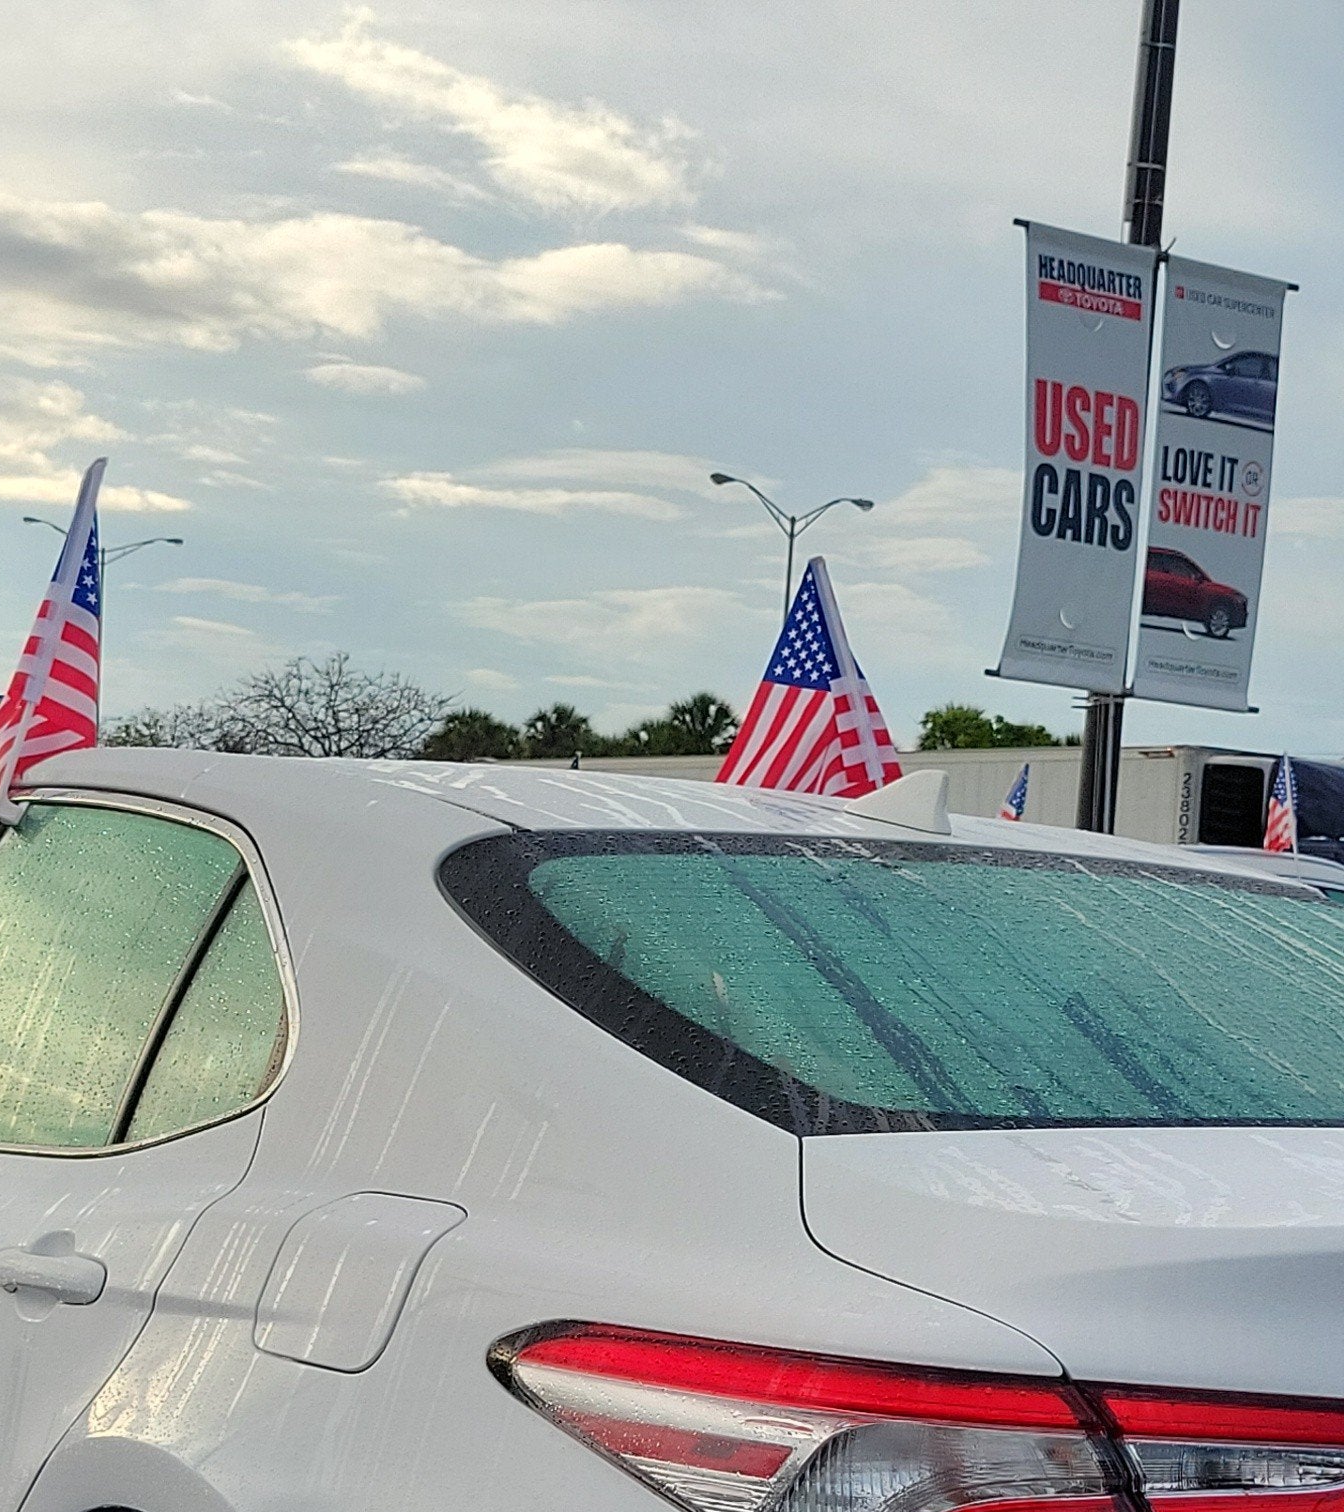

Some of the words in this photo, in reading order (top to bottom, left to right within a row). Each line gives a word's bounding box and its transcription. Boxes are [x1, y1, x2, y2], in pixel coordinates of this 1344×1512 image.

[1038, 254, 1142, 300] HEADQUARTER
[1075, 292, 1124, 316] TOYOTA
[1033, 378, 1139, 472] USED
[1161, 445, 1214, 489] LOVE
[1218, 455, 1239, 493] IT
[1031, 462, 1136, 552] CARS
[1158, 488, 1238, 534] SWITCH
[1242, 502, 1262, 538] IT
